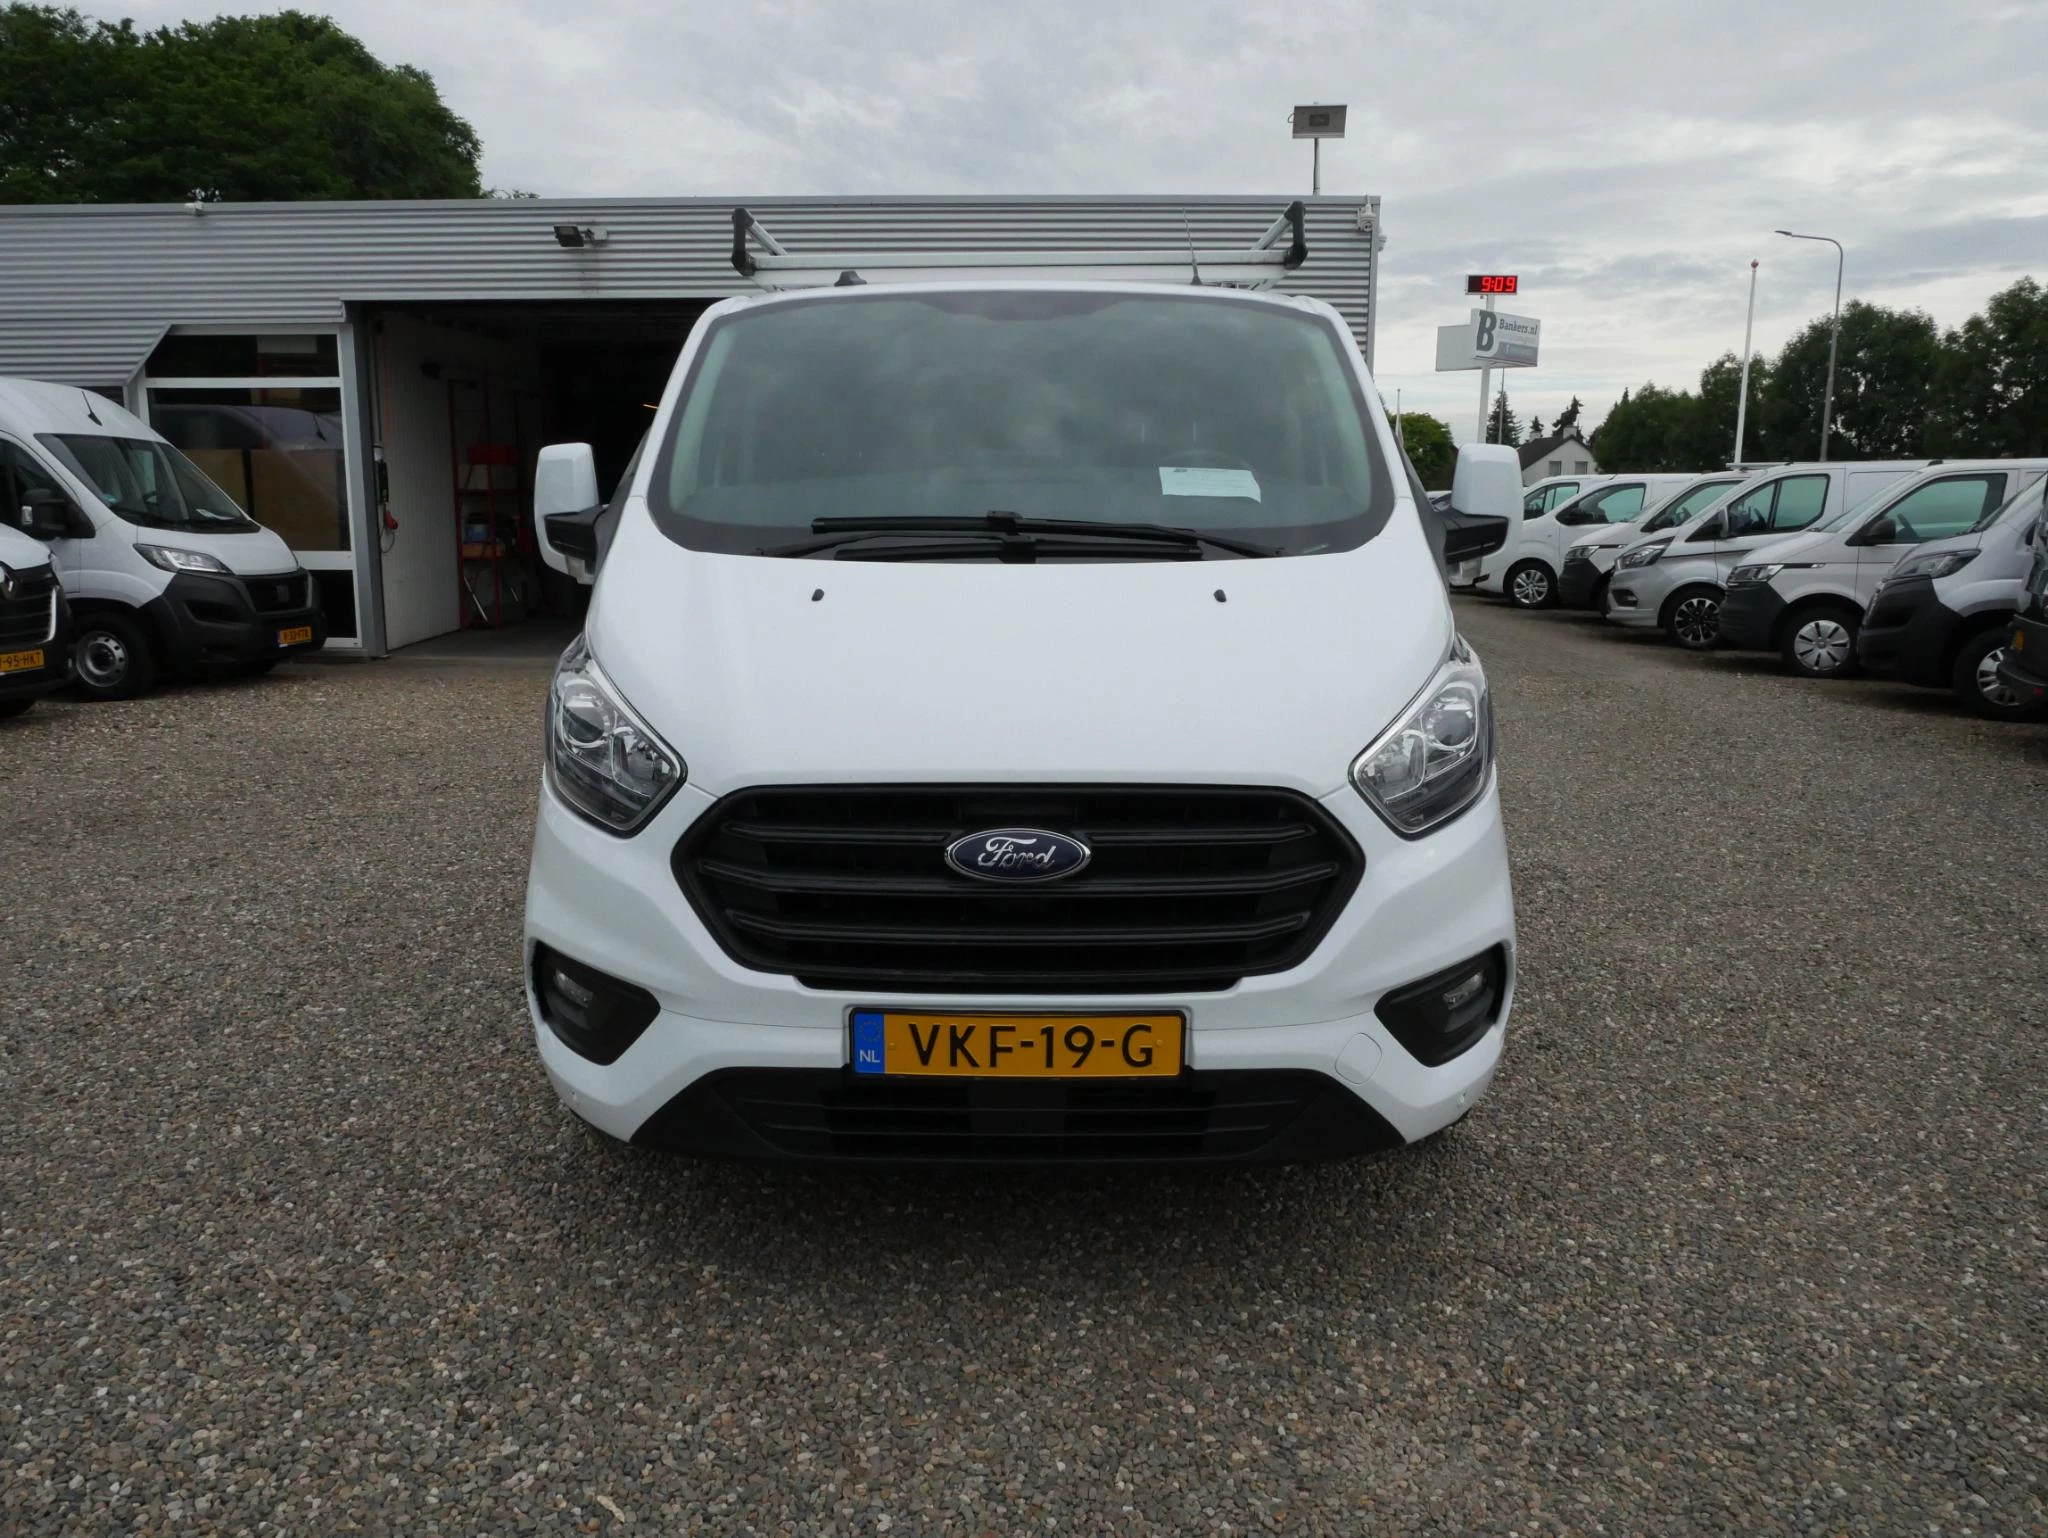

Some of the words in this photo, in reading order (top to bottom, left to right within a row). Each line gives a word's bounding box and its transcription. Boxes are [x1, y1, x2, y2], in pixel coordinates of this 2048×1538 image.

[1481, 276, 1516, 292] 9:09
[1476, 309, 1497, 352] B
[1499, 318, 1539, 336] Bankers.nl
[977, 836, 1057, 869] Ford
[859, 1049, 881, 1064] NL
[908, 1023, 1154, 1069] VKF-19-G
